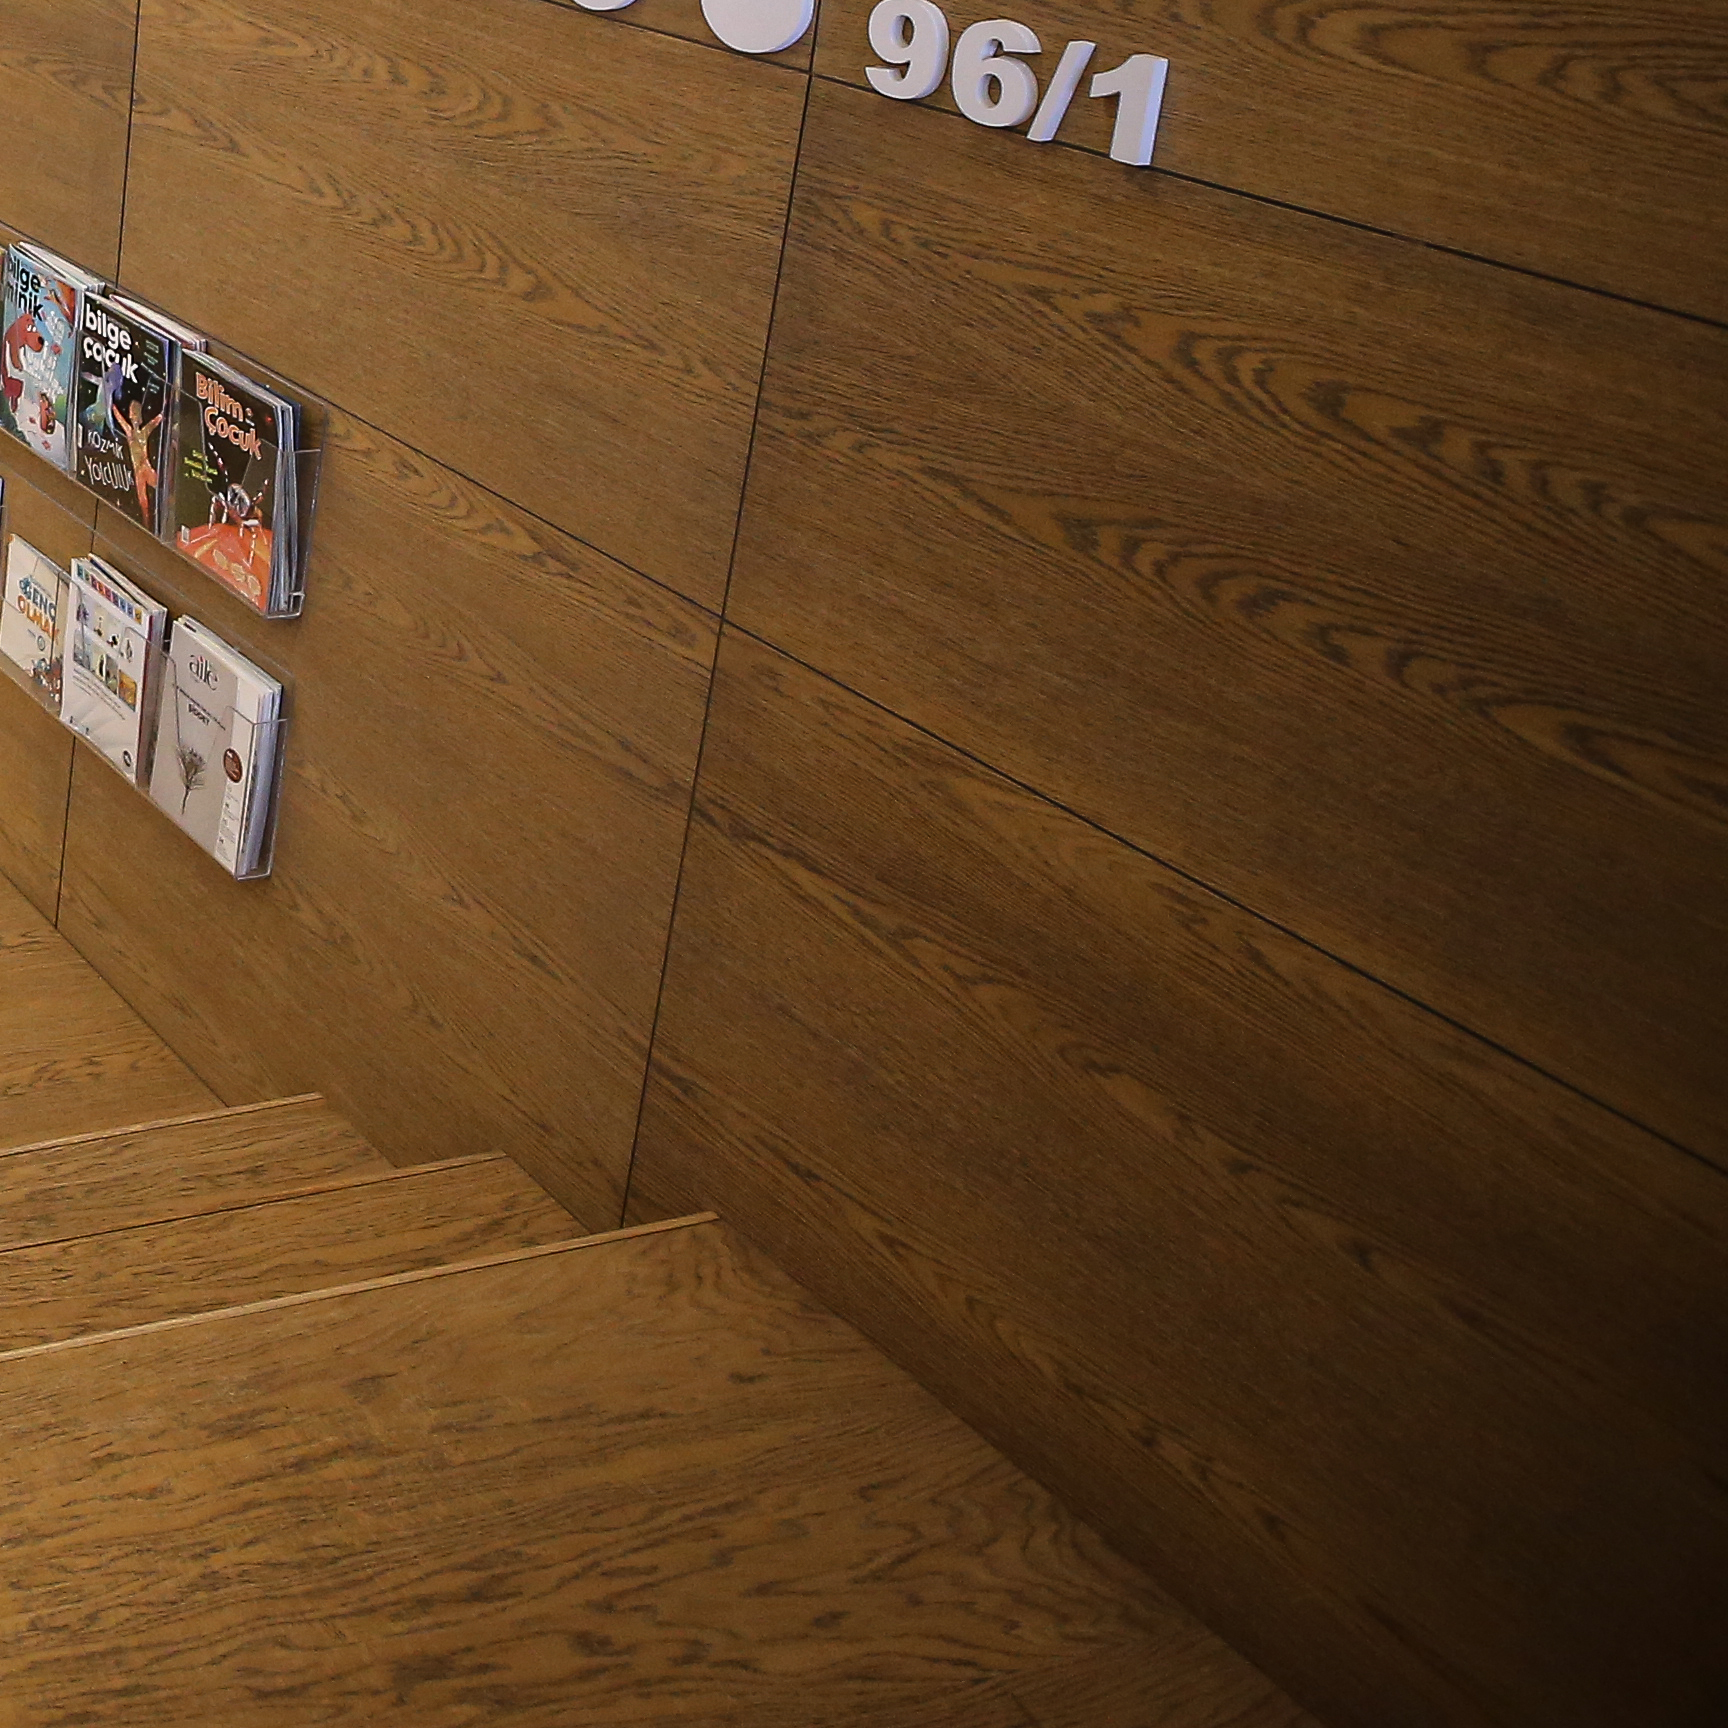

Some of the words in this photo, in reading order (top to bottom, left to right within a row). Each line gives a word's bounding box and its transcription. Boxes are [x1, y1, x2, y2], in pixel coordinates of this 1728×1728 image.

[85, 302, 133, 351] bilge
[83, 336, 139, 384] çocuk
[196, 371, 244, 422] Bilim
[204, 406, 262, 461] Çocuk
[189, 654, 218, 691] aile
